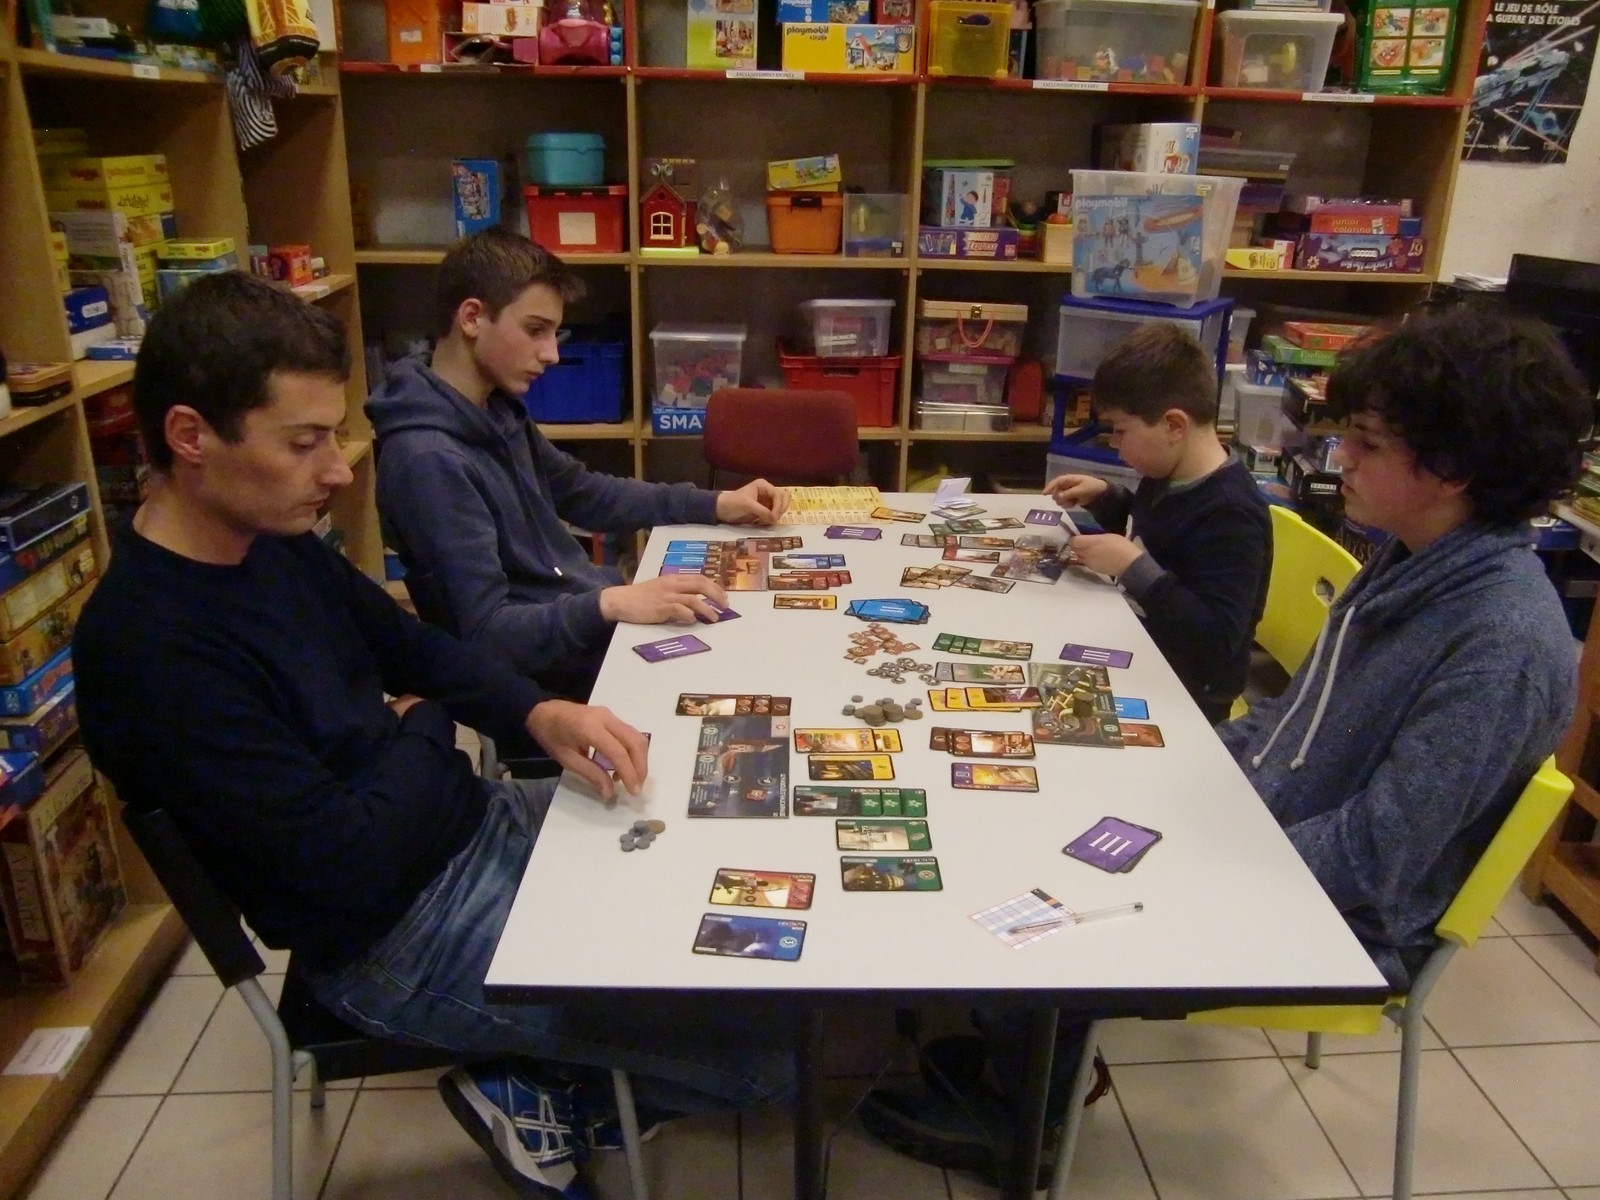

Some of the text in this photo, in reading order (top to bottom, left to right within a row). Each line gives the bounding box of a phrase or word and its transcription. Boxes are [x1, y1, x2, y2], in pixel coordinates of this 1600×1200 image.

[1494, 2, 1560, 14] LE JEU DE RÔLE
[1495, 14, 1526, 24] GUERRE
[1528, 15, 1545, 25] DES
[786, 26, 829, 36] playmobil
[1075, 197, 1128, 210] playmobil
[659, 414, 706, 430] SMA
[1088, 830, 1133, 857] III
